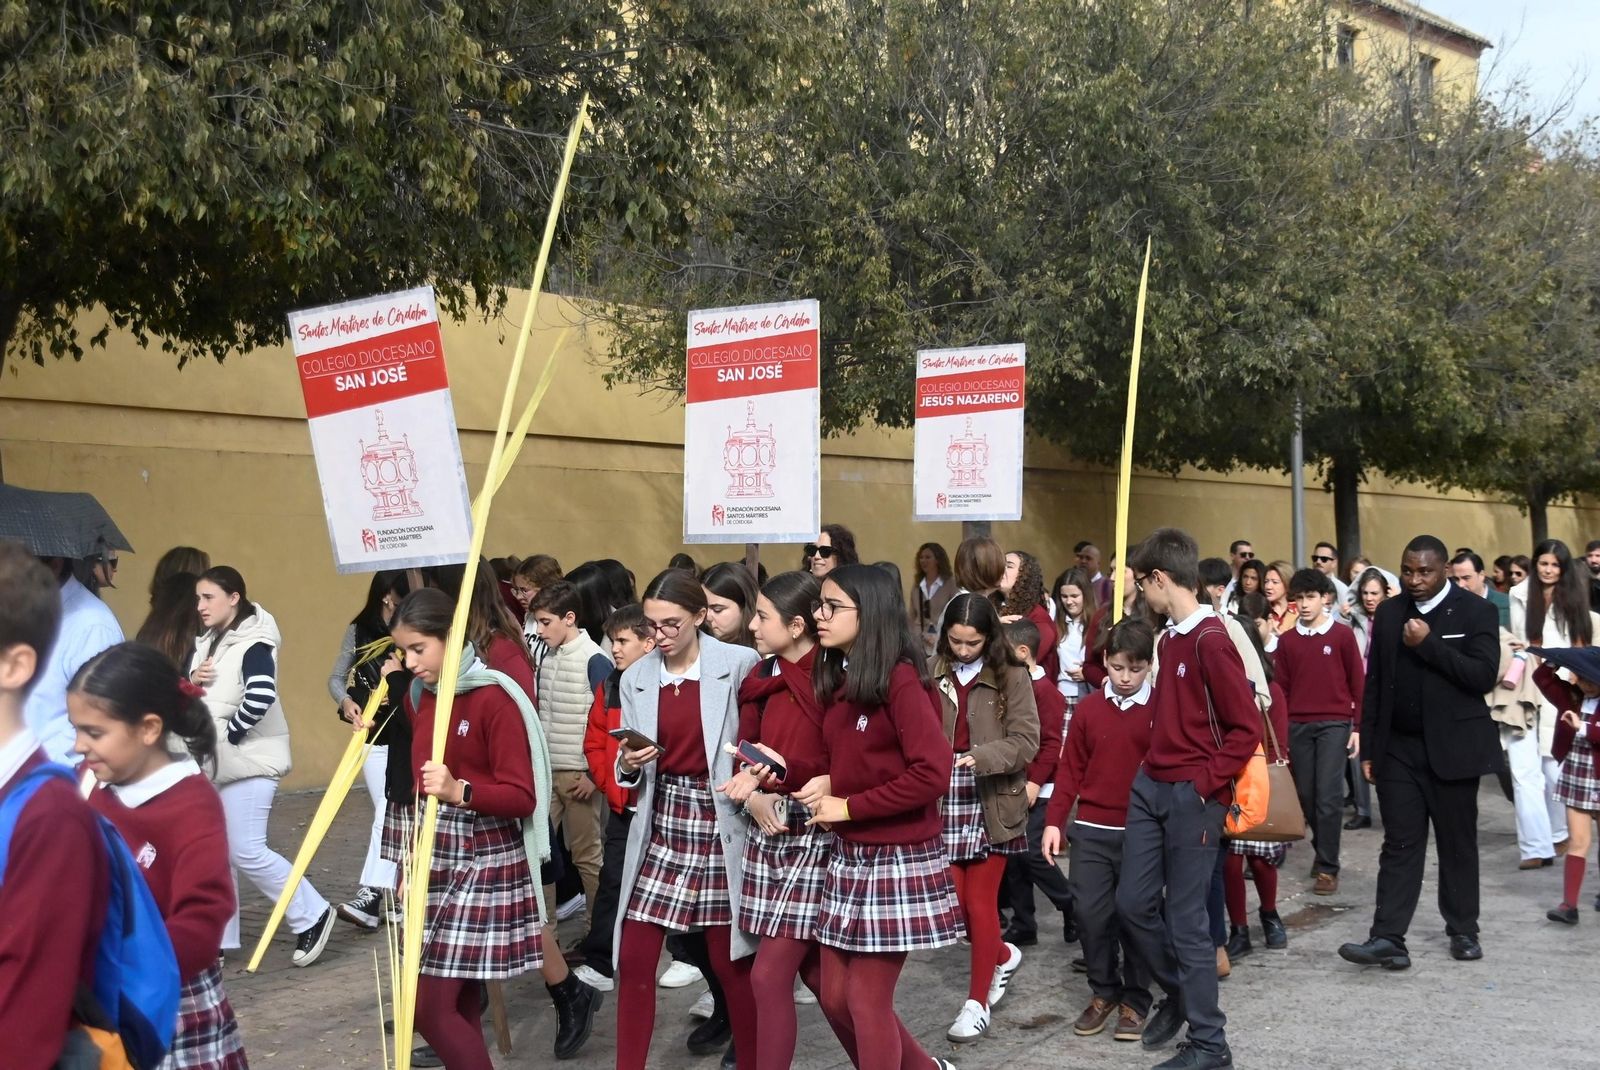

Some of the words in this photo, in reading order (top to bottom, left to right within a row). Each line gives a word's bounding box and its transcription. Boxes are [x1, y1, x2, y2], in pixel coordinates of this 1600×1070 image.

[298, 320, 329, 341] Santos
[330, 314, 370, 336] Mártires
[372, 310, 385, 326] de
[388, 303, 428, 326] Córdoba
[694, 320, 721, 336] Santos
[761, 315, 772, 328] de
[774, 312, 811, 330] Córdoba
[302, 354, 357, 375] COLEGIO
[359, 340, 435, 366] DIOCESANO
[691, 349, 740, 366] COLEGIO
[743, 344, 812, 362] DIOCESANO
[922, 357, 945, 369] Santos
[978, 354, 986, 364] de
[335, 371, 367, 392] SAN
[369, 363, 408, 386] JOSÉ
[717, 367, 745, 383] SAN
[748, 360, 783, 380] JOSÉ
[920, 382, 962, 393] COLEGIO
[963, 379, 1020, 391] DIOCESANO
[919, 393, 954, 407] JESÚS
[956, 392, 1019, 406] NAZARENO
[377, 527, 406, 536] FUNDACIÓN
[406, 525, 434, 533] DIOCESANA
[378, 535, 398, 544] SANTOS
